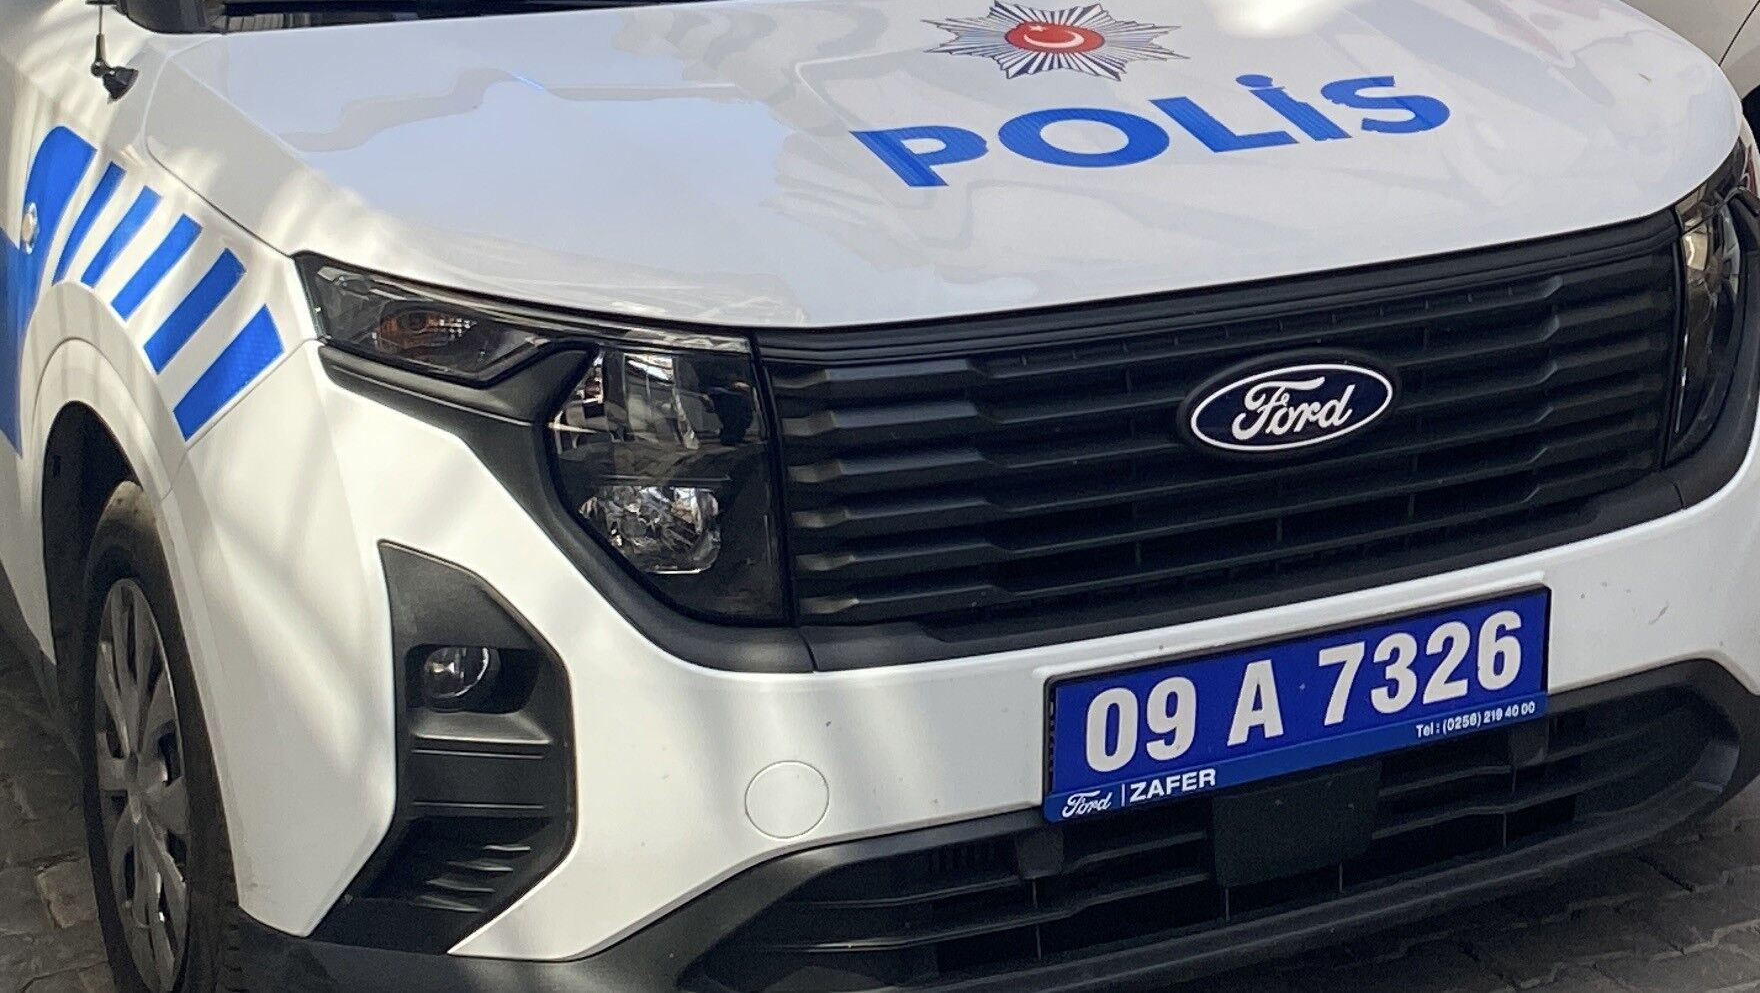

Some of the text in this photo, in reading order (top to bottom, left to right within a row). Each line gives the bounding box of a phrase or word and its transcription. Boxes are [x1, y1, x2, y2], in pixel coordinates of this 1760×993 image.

[849, 74, 1451, 187] POLİS
[1231, 376, 1356, 440] Ford
[1086, 610, 1522, 772] 09 A 7326
[1505, 704, 1519, 717] 40
[1521, 701, 1536, 715] 00
[1062, 769, 1216, 818] Ford ZAFER
